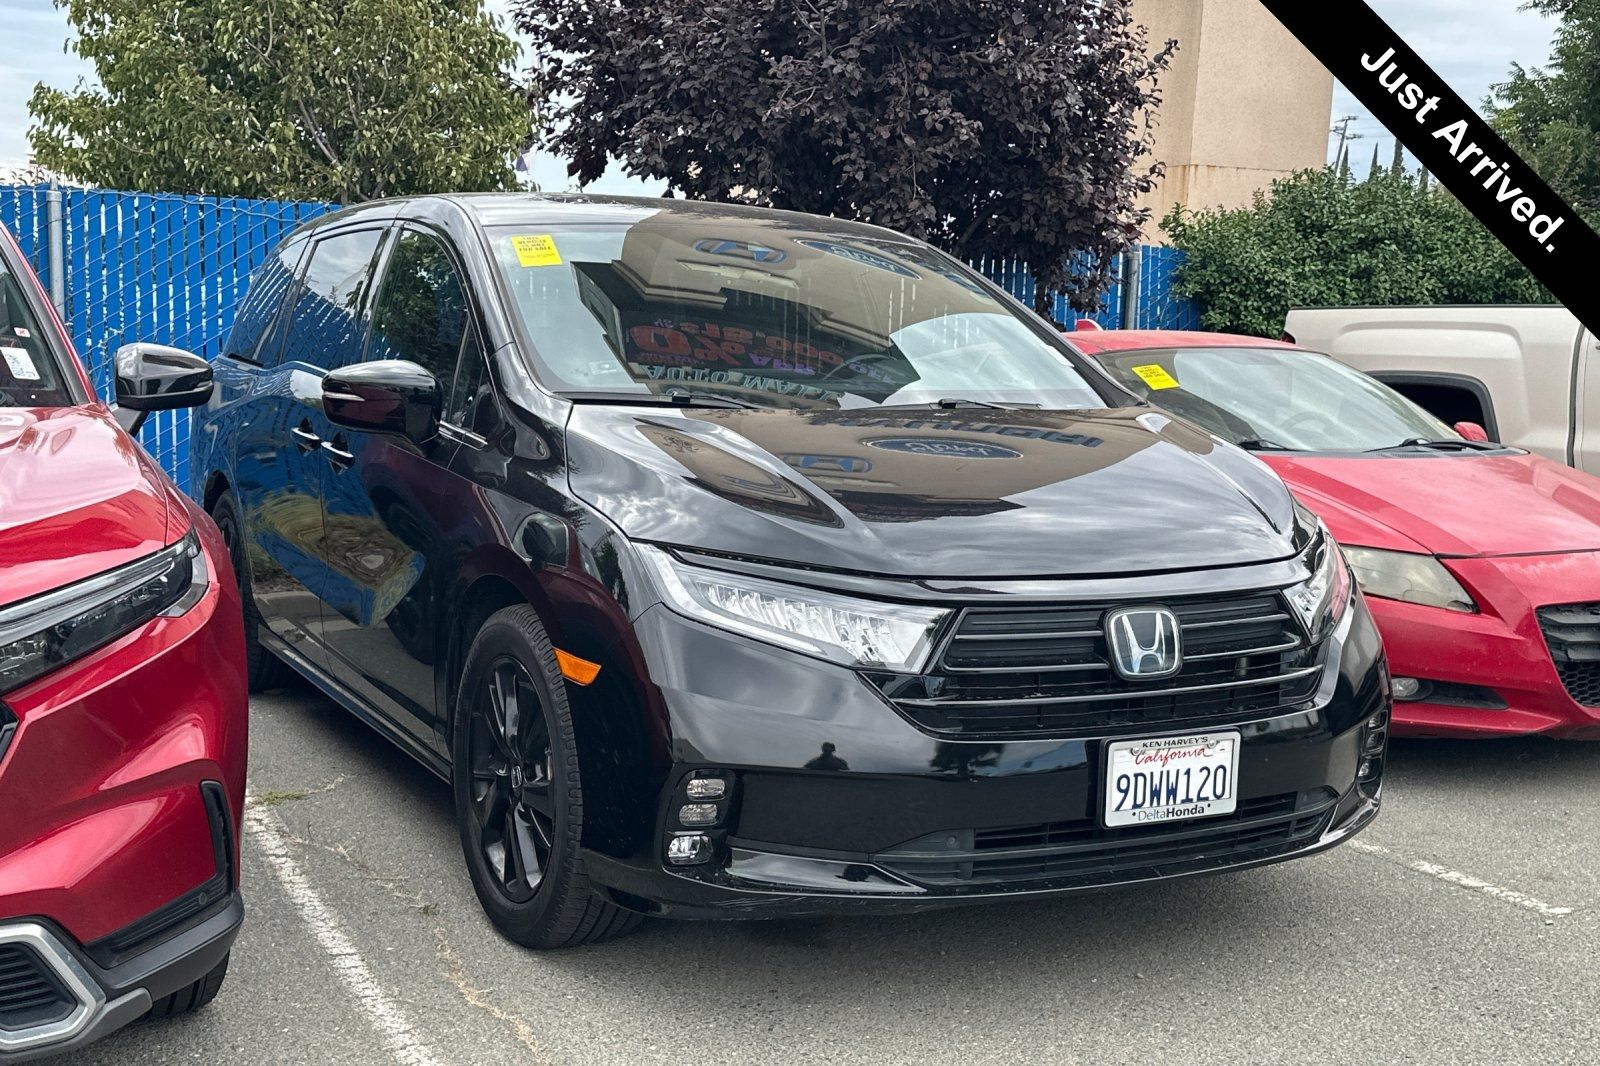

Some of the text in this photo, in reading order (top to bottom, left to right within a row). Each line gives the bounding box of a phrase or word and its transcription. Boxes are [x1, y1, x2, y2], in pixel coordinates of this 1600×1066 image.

[1142, 736, 1209, 748] KEN HARVEY'S
[1135, 746, 1214, 767] California
[1115, 764, 1227, 811] 9DWW120
[1138, 804, 1205, 821] DeltaHonda
